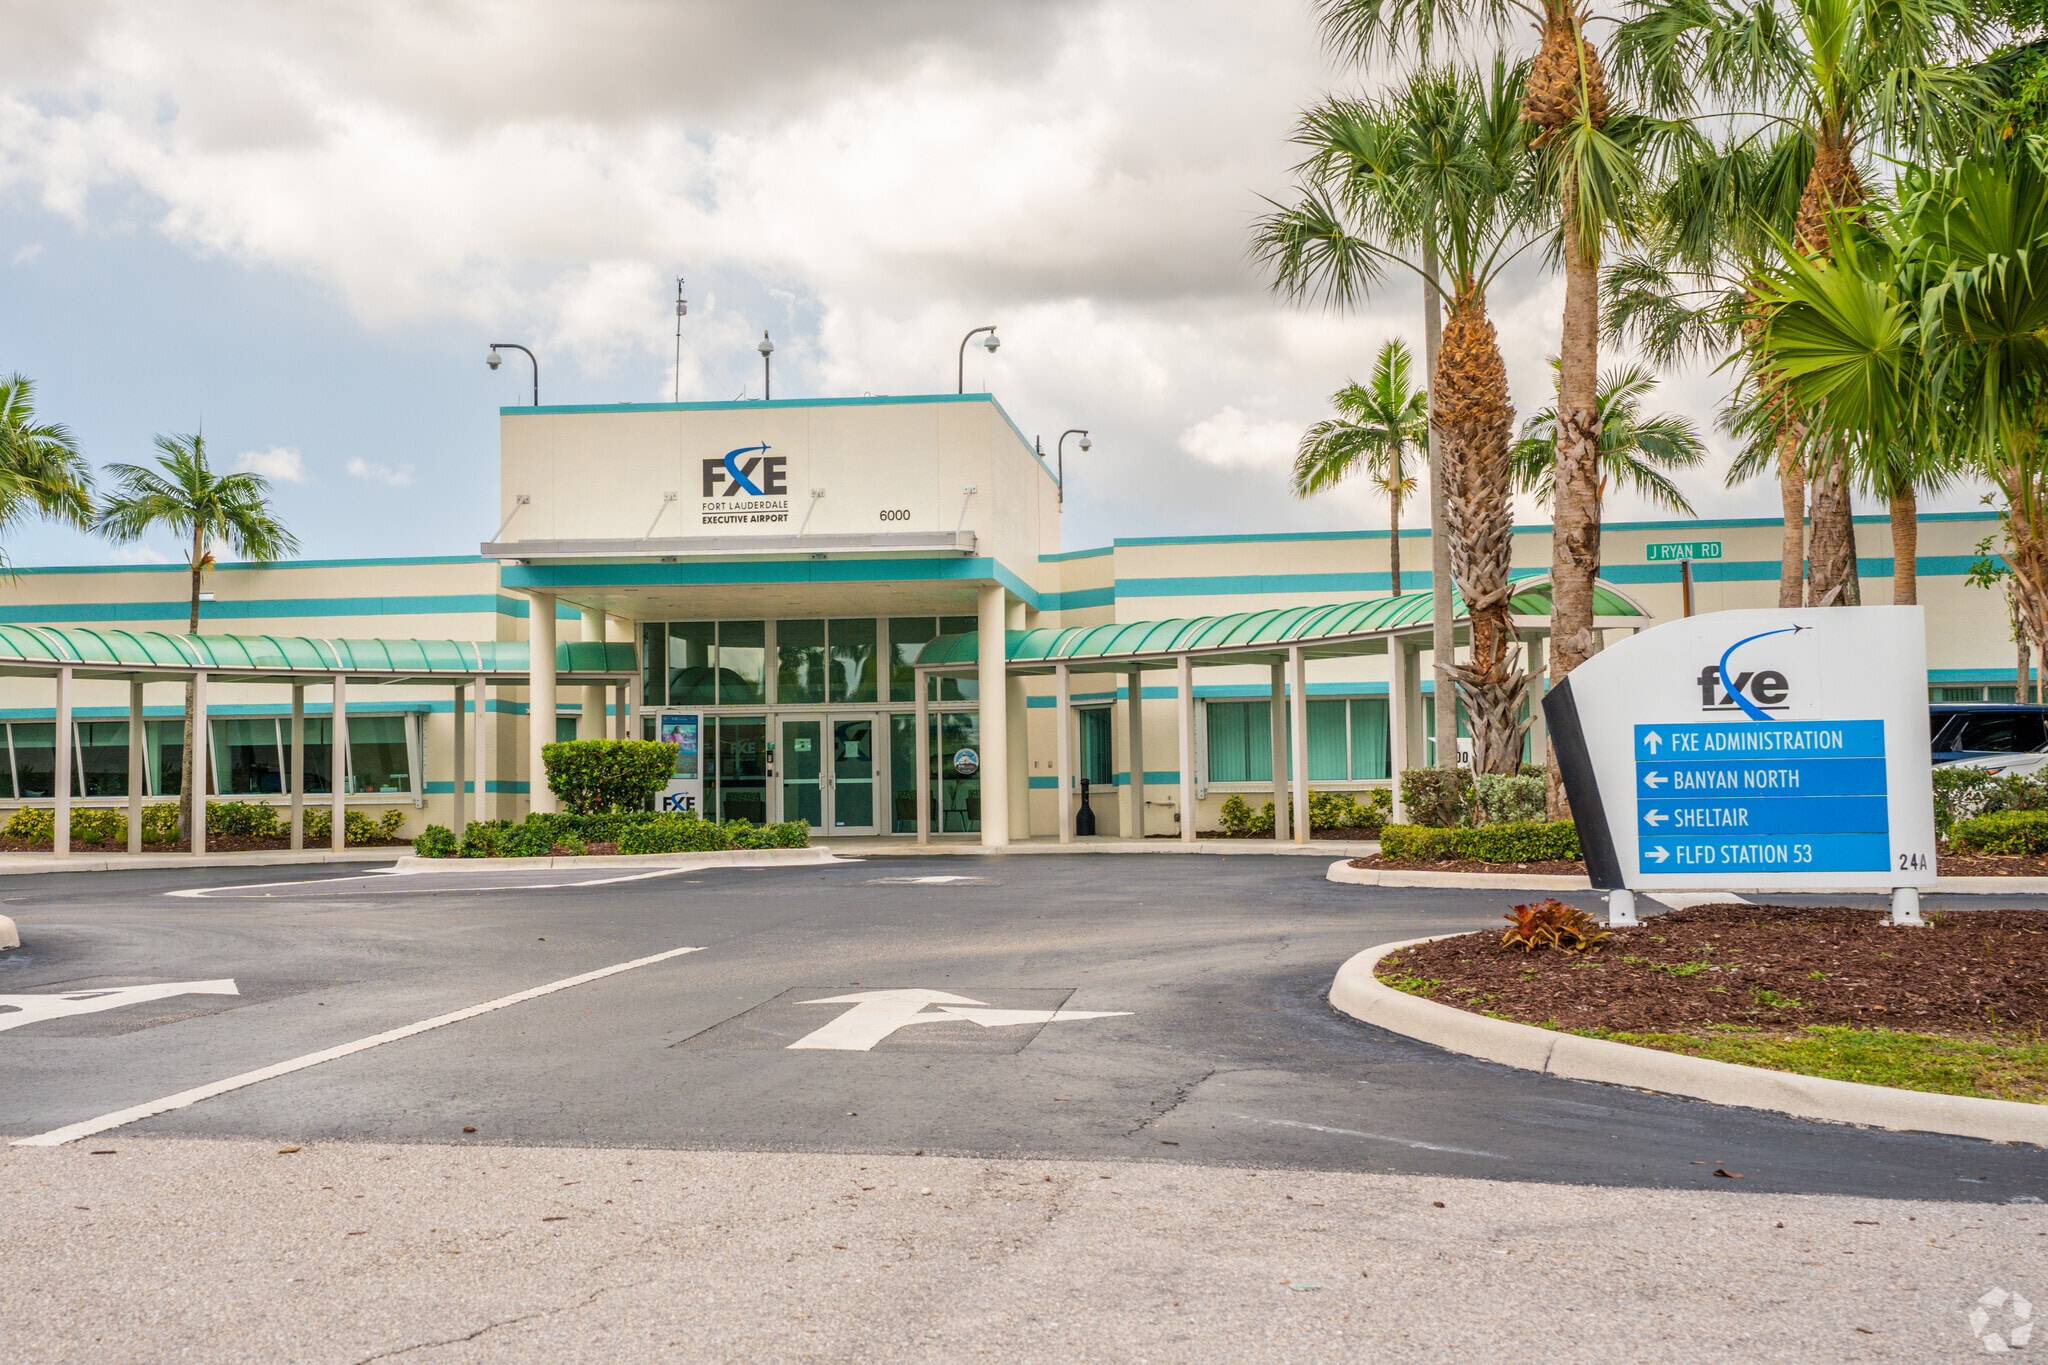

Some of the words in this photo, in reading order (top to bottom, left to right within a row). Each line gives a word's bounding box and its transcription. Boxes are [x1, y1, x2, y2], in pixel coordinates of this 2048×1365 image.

[703, 456, 787, 498] FXE
[702, 502, 726, 511] FORT
[729, 501, 788, 510] LAUDERDALE
[880, 509, 911, 521] 6000
[702, 515, 748, 524] EXECUTIVE
[750, 514, 788, 523] AIRPORT
[1649, 545, 1657, 559] J
[1661, 545, 1693, 558] RYAN
[1701, 543, 1719, 557] RD
[1696, 665, 1789, 706] fxe
[1672, 733, 1699, 752] FXE
[1704, 730, 1843, 751] ADMINISTRATION
[1674, 771, 1738, 790] BANYAN
[1744, 769, 1800, 788] NORTH
[1674, 808, 1749, 828] SHELTAIR
[1676, 845, 1716, 865] FLFD
[1721, 844, 1788, 864] STATION
[1793, 844, 1812, 863] 53
[1899, 853, 1928, 871] 24A
